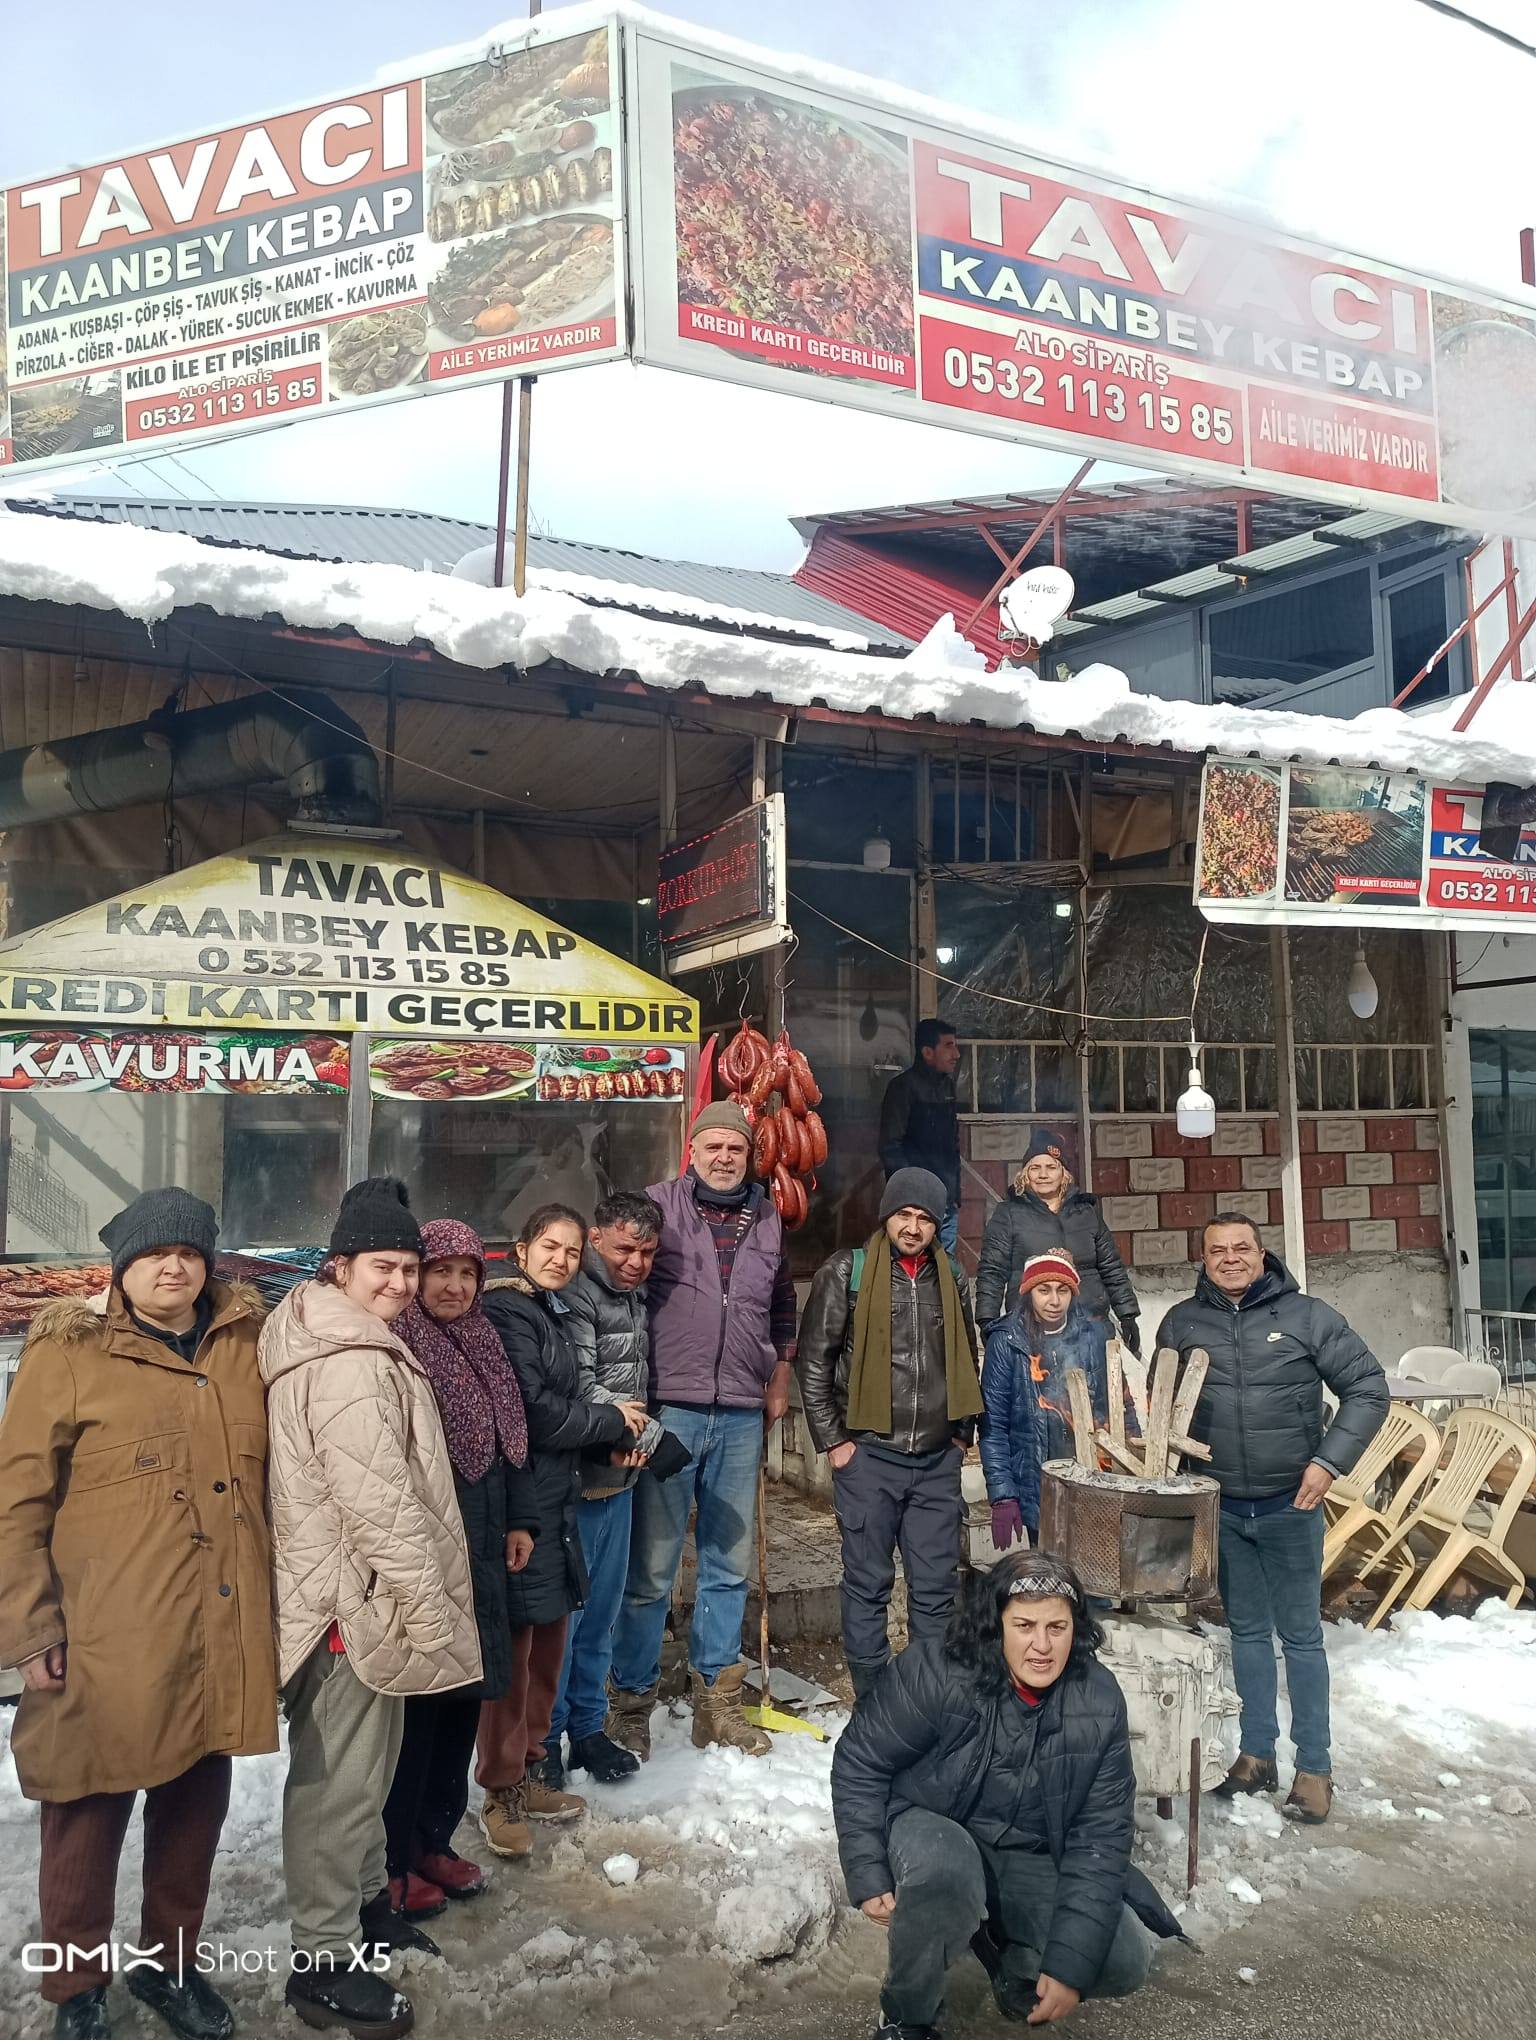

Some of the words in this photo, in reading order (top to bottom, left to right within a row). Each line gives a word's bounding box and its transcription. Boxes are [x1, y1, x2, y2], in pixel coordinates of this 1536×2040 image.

[20, 87, 409, 258] TAVACI
[21, 230, 235, 318] KAANBEY
[247, 187, 414, 266] KEBAP
[936, 157, 1417, 355] TAVACI
[16, 352, 67, 378] PİRZOLA
[77, 341, 115, 364] CİĞER
[125, 329, 169, 354] DALAK
[179, 317, 225, 343] YÜREK
[235, 303, 282, 331] SUCUK
[285, 292, 334, 320] EKMEK
[346, 273, 418, 305] KAVURMA
[17, 326, 60, 351] ADANA
[70, 311, 124, 339] KUŞBAŞI
[135, 301, 160, 328] ÇÖP
[163, 295, 184, 323] ŞİŞ
[195, 285, 238, 312] TAVUK
[241, 277, 263, 303] ŞİŞ
[275, 266, 322, 294] KANAT
[335, 251, 373, 280] İNCİK
[387, 242, 415, 271] ÇÖZ
[939, 249, 1237, 358] KAANBEY
[1252, 331, 1423, 400] KEBAP
[126, 365, 167, 390] KİLO
[173, 358, 200, 381] İLE
[205, 353, 227, 374] ET
[232, 331, 321, 369] PİŞİRİLİR
[440, 351, 474, 372] AİLE
[476, 335, 540, 363] YERİMİZ
[542, 326, 601, 350] VARDIR
[691, 311, 745, 339] KREDİ
[751, 325, 802, 352] KARTI
[807, 339, 905, 376] GEÇERLİDİR
[1014, 329, 1066, 361] ALO
[1070, 340, 1171, 390] SİPARİŞ
[139, 402, 196, 431] 0532
[202, 391, 246, 419] 113
[252, 384, 281, 409] 15
[286, 376, 317, 402] 85
[177, 382, 208, 400] ALO
[212, 369, 273, 394] SİPARİŞ
[943, 347, 1046, 407] 0532
[1057, 372, 1127, 423] 113
[1138, 391, 1182, 434] 15
[1190, 402, 1234, 445] 85
[1259, 399, 1298, 448] AİLE
[1300, 414, 1369, 462] YERİMİZ
[1370, 430, 1430, 474] VARDIR
[247, 855, 445, 909] TAVACI
[1440, 880, 1498, 902] 0532
[1482, 867, 1513, 880] ALO
[106, 902, 389, 950] KAANBEY
[404, 921, 577, 960] KEBAP
[198, 946, 230, 973] 0
[242, 948, 324, 977] 532
[333, 953, 397, 981] 113
[406, 958, 450, 984] 15
[460, 961, 510, 987] 85
[188, 985, 368, 1022] KARTI
[0, 1040, 319, 1082] KAVURMA
